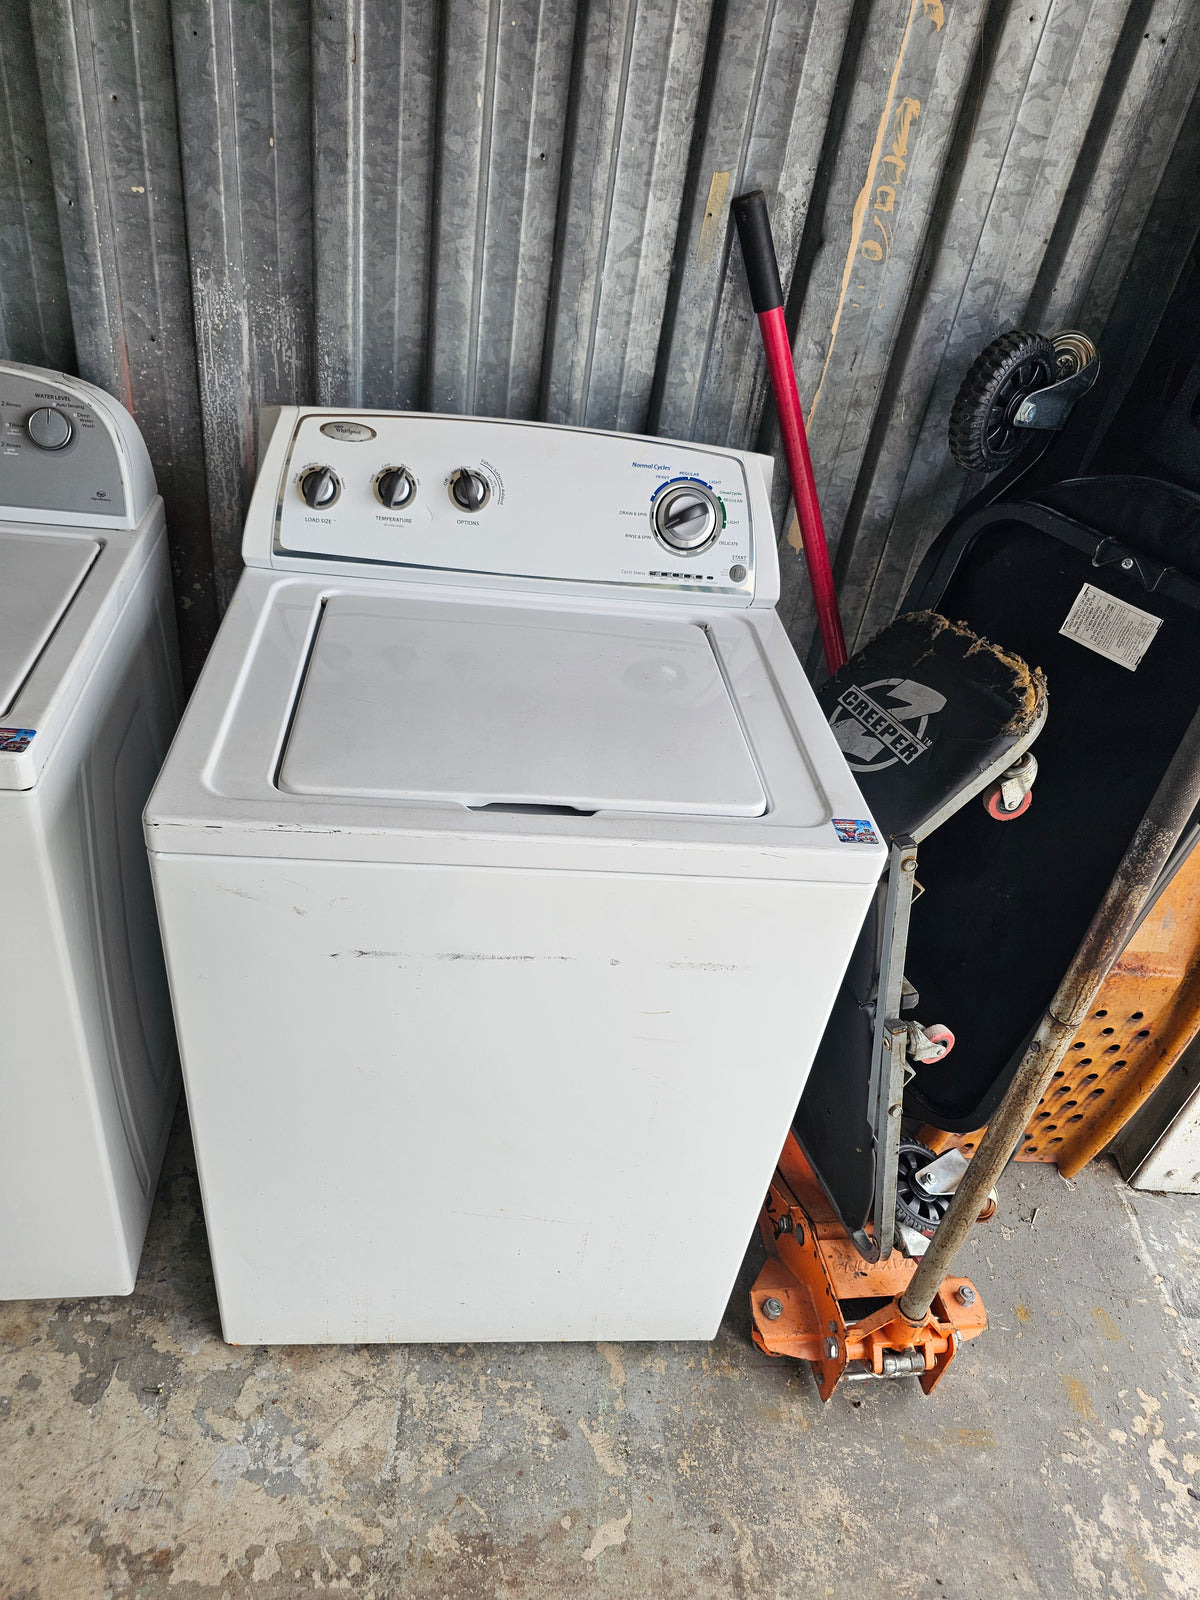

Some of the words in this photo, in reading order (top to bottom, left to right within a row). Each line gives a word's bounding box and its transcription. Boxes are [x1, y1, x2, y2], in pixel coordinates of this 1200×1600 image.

[35, 392, 54, 400] WATER
[54, 394, 71, 402] LEVEL
[335, 426, 361, 436] Whirlpool
[376, 515, 412, 523] TEMPERATURE
[842, 690, 919, 761] CREEPER
